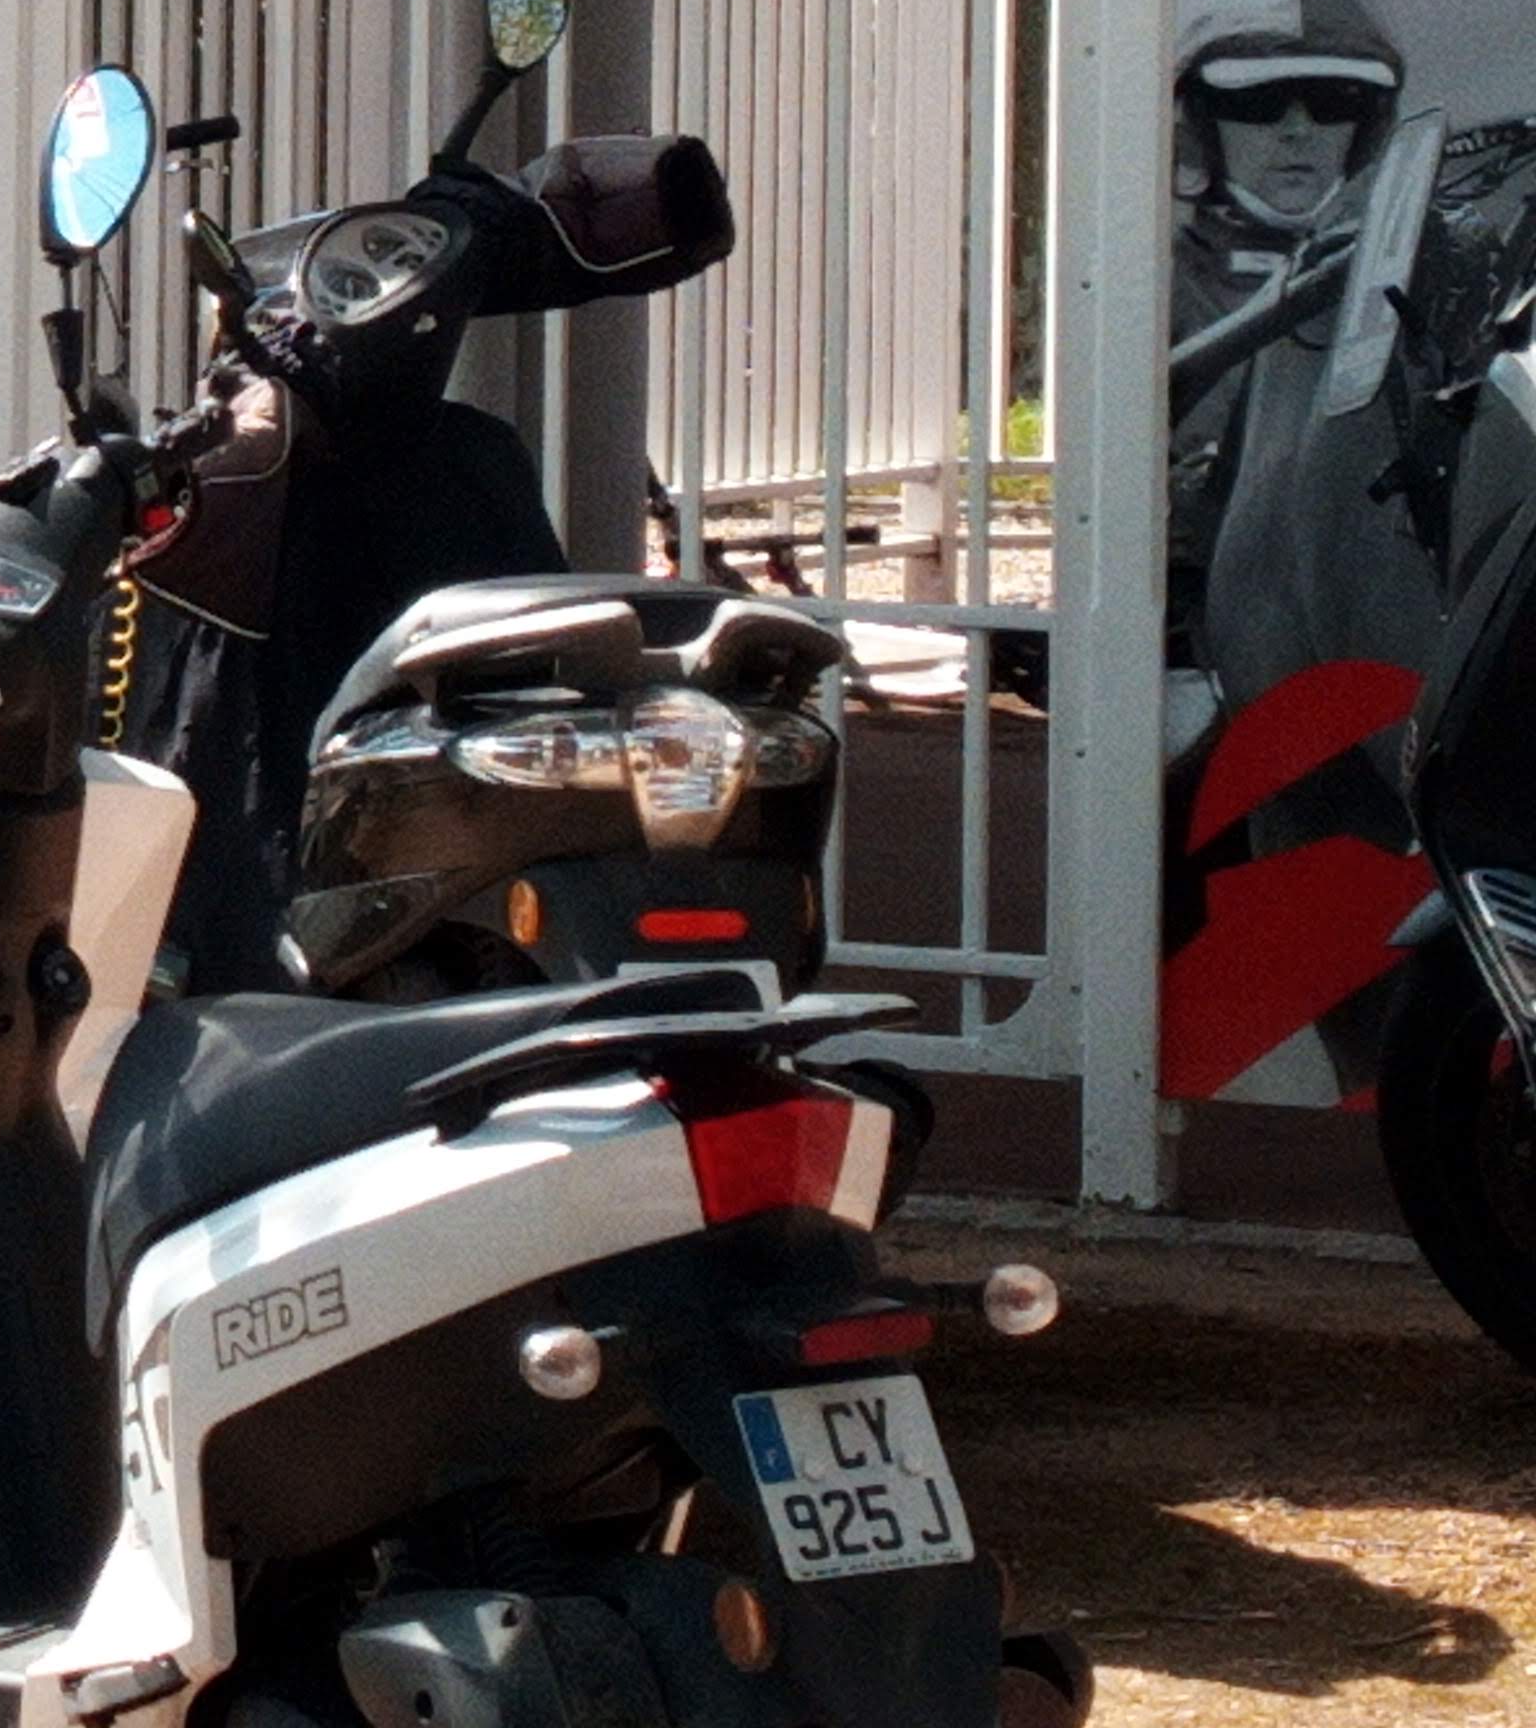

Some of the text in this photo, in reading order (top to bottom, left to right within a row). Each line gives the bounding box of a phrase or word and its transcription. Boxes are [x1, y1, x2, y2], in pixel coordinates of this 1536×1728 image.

[822, 1396, 894, 1470] CY
[783, 1477, 951, 1561] 925 J
